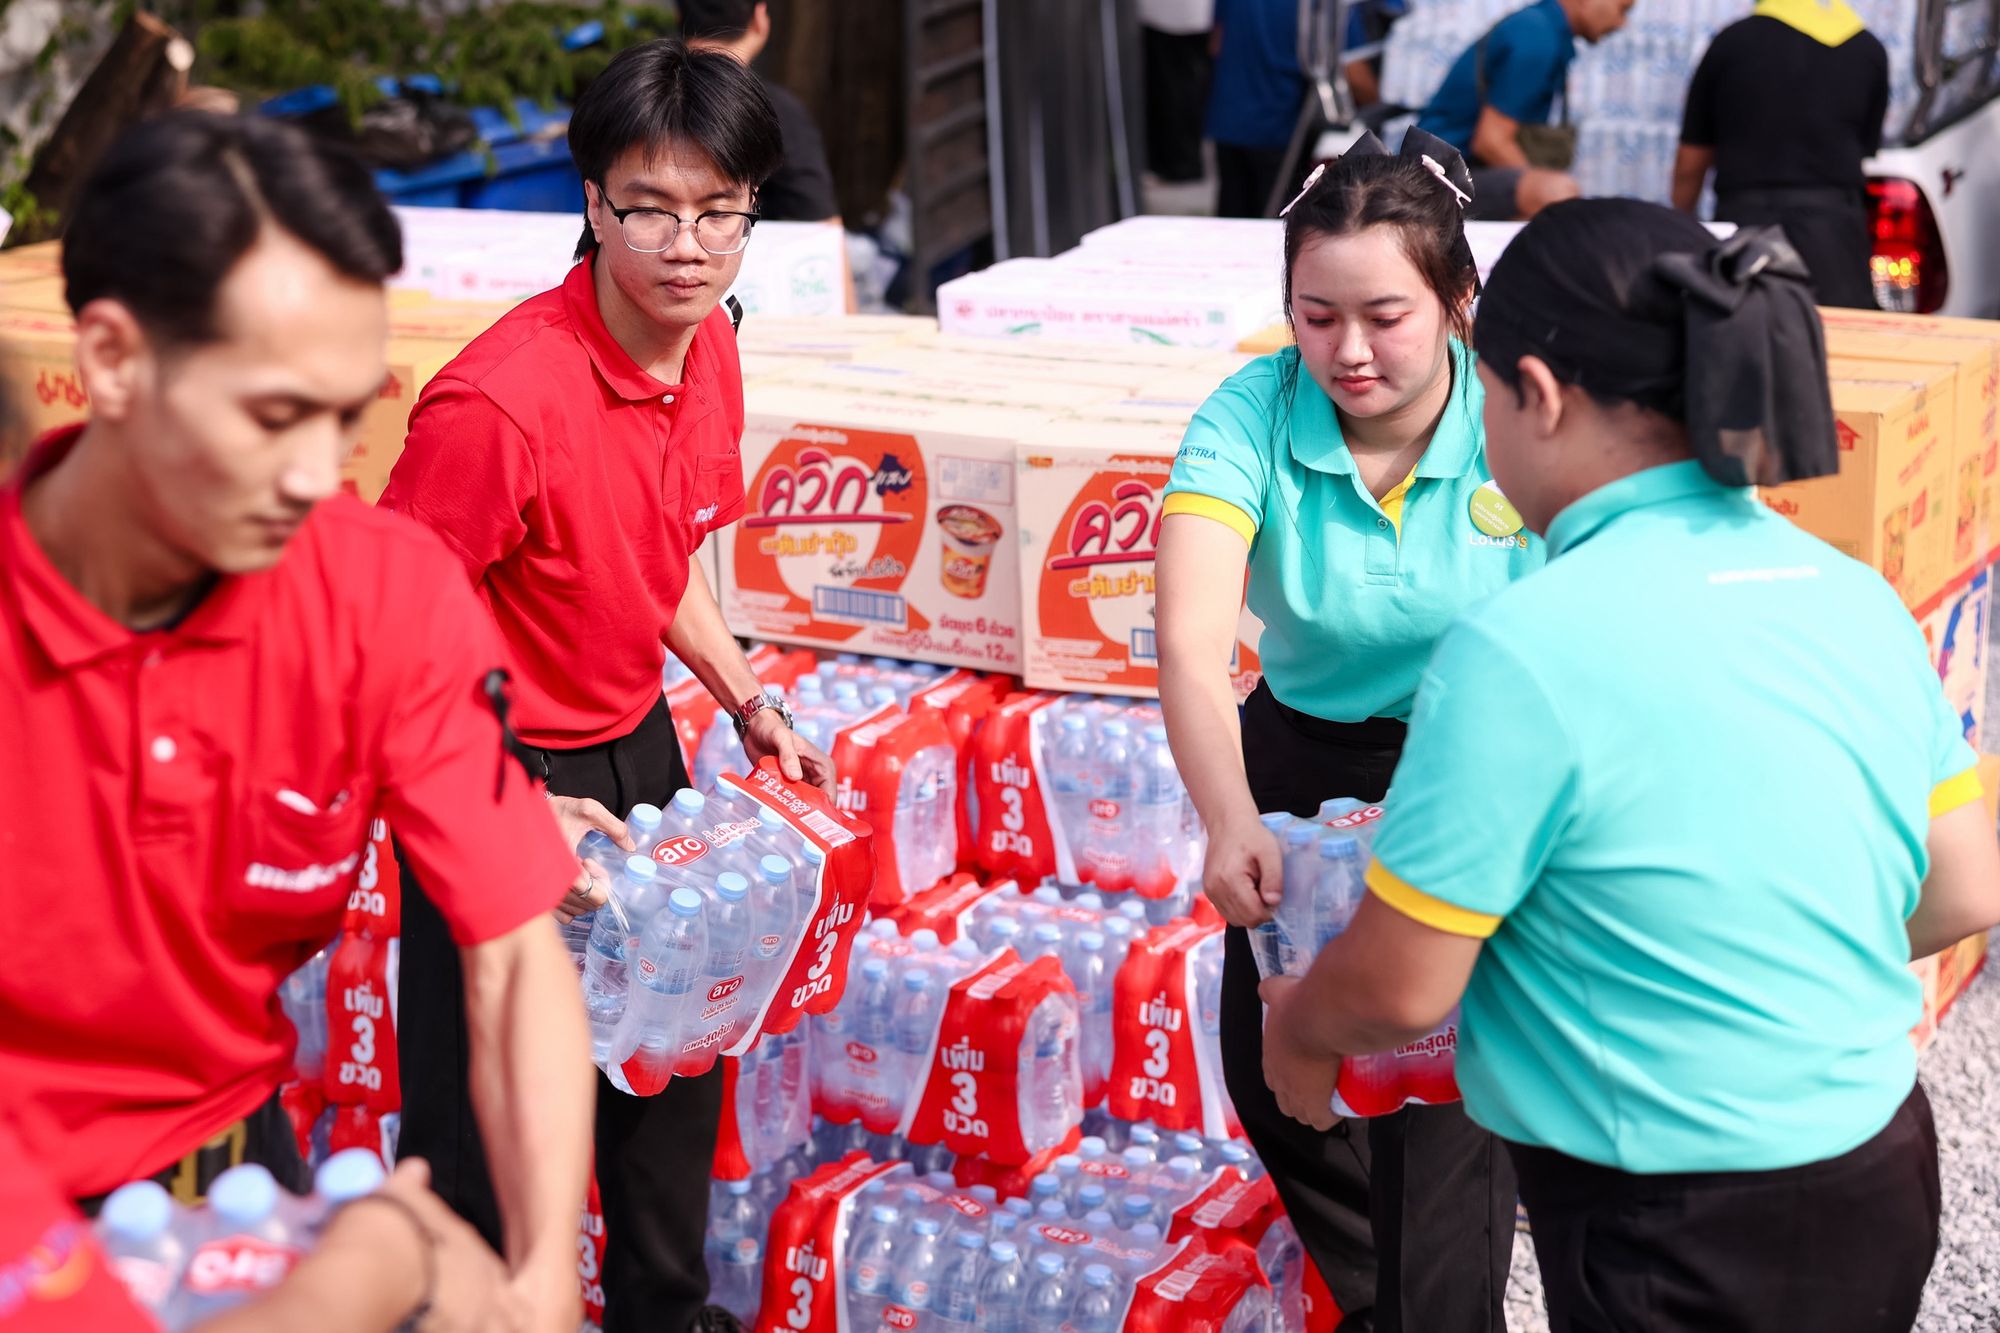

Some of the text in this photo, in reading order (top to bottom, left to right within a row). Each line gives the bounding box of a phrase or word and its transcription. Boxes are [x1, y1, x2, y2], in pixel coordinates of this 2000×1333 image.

[761, 450, 869, 517] ควิก
[1070, 482, 1163, 556] ควิ
[991, 752, 1030, 788] เพิ่ม
[792, 798, 812, 813] 600
[1001, 787, 1025, 832] 3
[657, 836, 703, 865] aro
[991, 829, 1034, 858] ขวด
[814, 892, 855, 940] เพิ่ม
[807, 933, 839, 981] 3
[345, 980, 384, 1020] เพิ่ม
[712, 979, 740, 998] aro
[791, 973, 833, 1010] ขวด
[1138, 991, 1182, 1032] เพิ่ม
[351, 1016, 376, 1065] 3
[941, 1035, 985, 1072] เพิ่ม
[1143, 1030, 1170, 1079] 3
[339, 1061, 382, 1091] ขวด
[951, 1072, 978, 1117] 3
[1129, 1076, 1177, 1107] ขวด
[942, 1109, 989, 1140] ขวด
[1045, 1226, 1085, 1242] aro
[786, 1238, 828, 1282] เพิ่ม
[786, 1277, 814, 1330] 3
